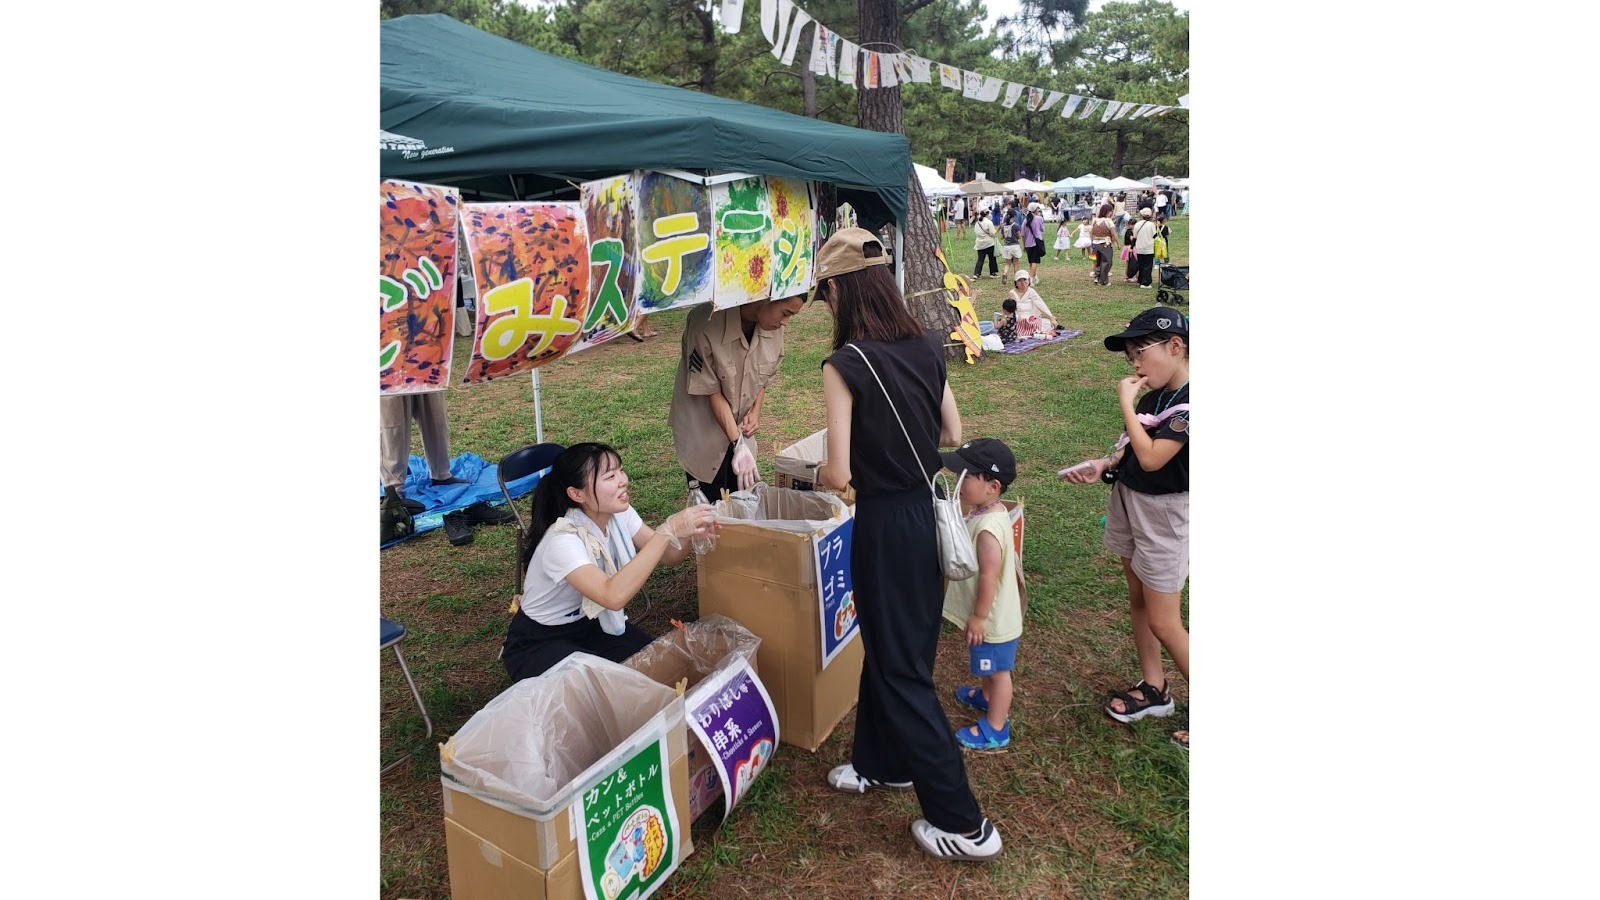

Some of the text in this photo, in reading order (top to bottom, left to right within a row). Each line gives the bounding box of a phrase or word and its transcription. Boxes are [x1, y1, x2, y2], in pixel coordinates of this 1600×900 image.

[402, 146, 455, 159] New generation
[820, 534, 843, 570] プラ
[824, 569, 845, 602] ゴミ
[712, 716, 742, 752] 串系
[587, 763, 659, 828] ペットボトル
[612, 807, 625, 823] PET
[625, 792, 644, 811] Bottles
